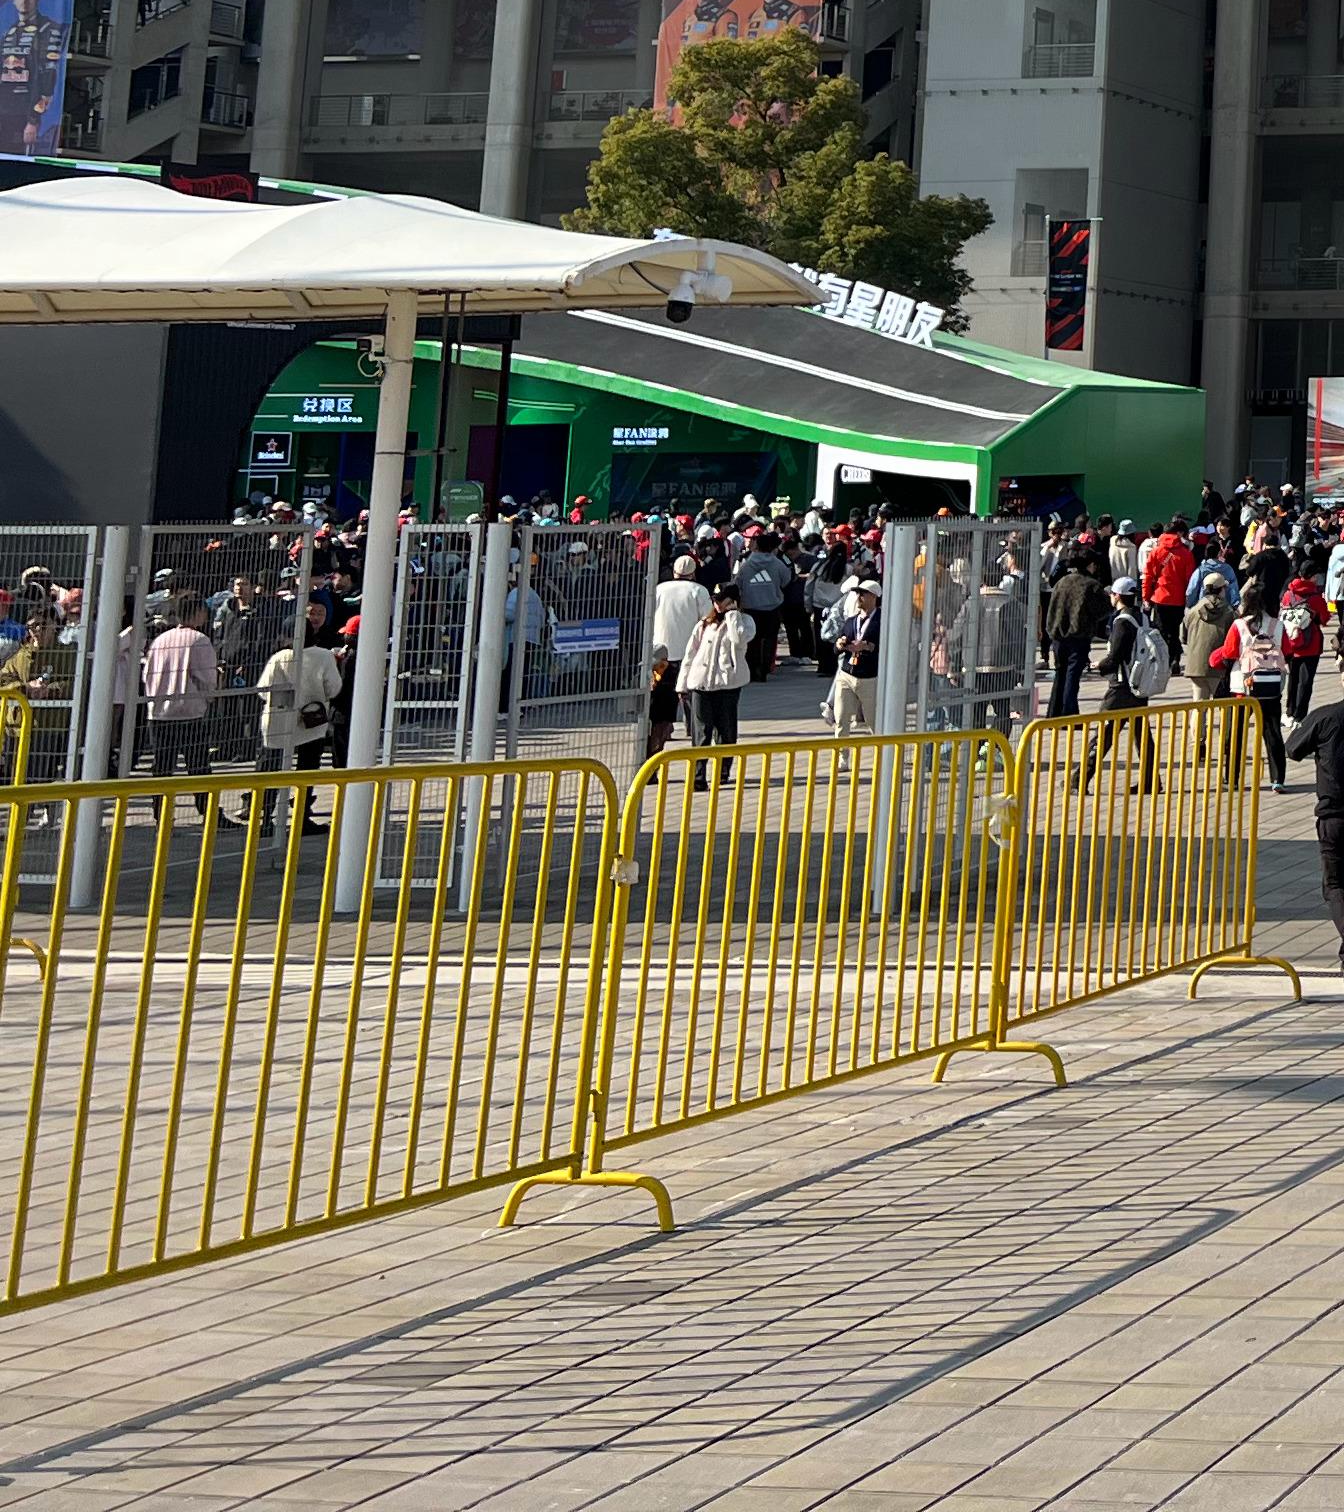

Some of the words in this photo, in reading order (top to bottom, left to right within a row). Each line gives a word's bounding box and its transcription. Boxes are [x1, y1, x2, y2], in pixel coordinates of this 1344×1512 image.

[302, 397, 354, 413] 兑换区
[292, 414, 341, 424] Redemption
[341, 414, 363, 423] Area
